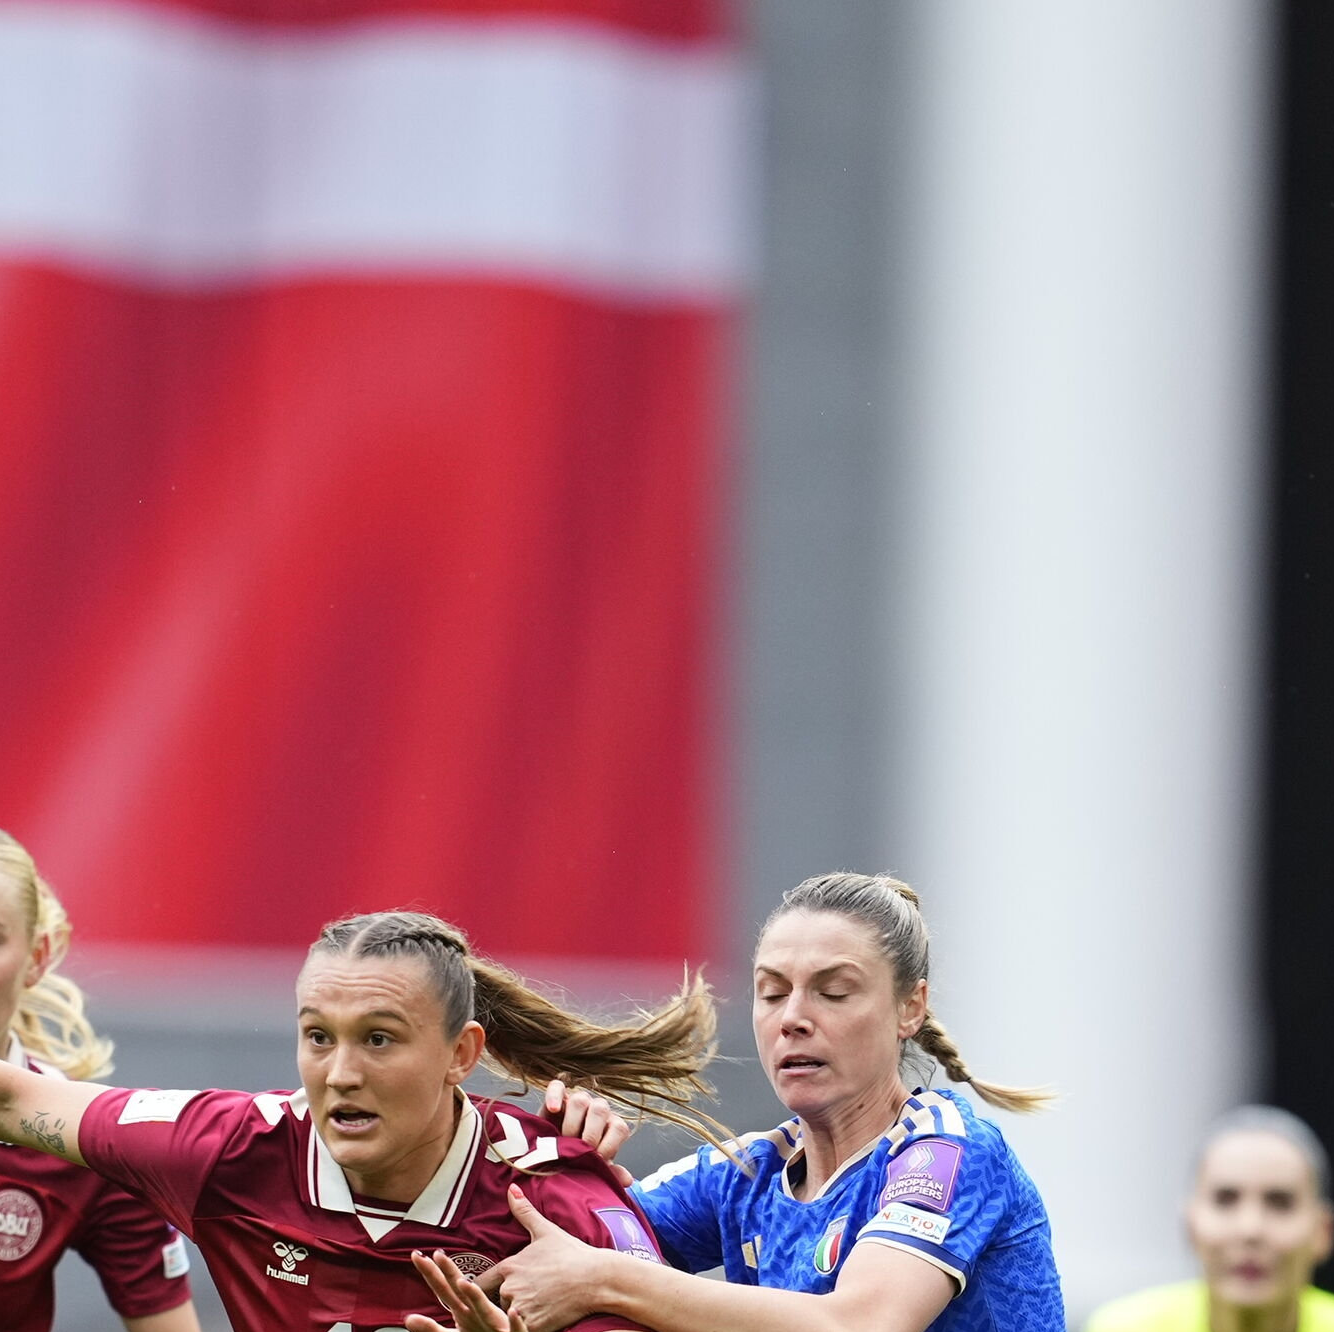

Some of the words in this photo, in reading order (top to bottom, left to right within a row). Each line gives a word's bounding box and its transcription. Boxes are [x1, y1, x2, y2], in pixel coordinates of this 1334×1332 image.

[886, 1178, 944, 1193] EUROPEAN
[884, 1186, 944, 1202] QUALIFIERS
[266, 1264, 309, 1286] hummel
